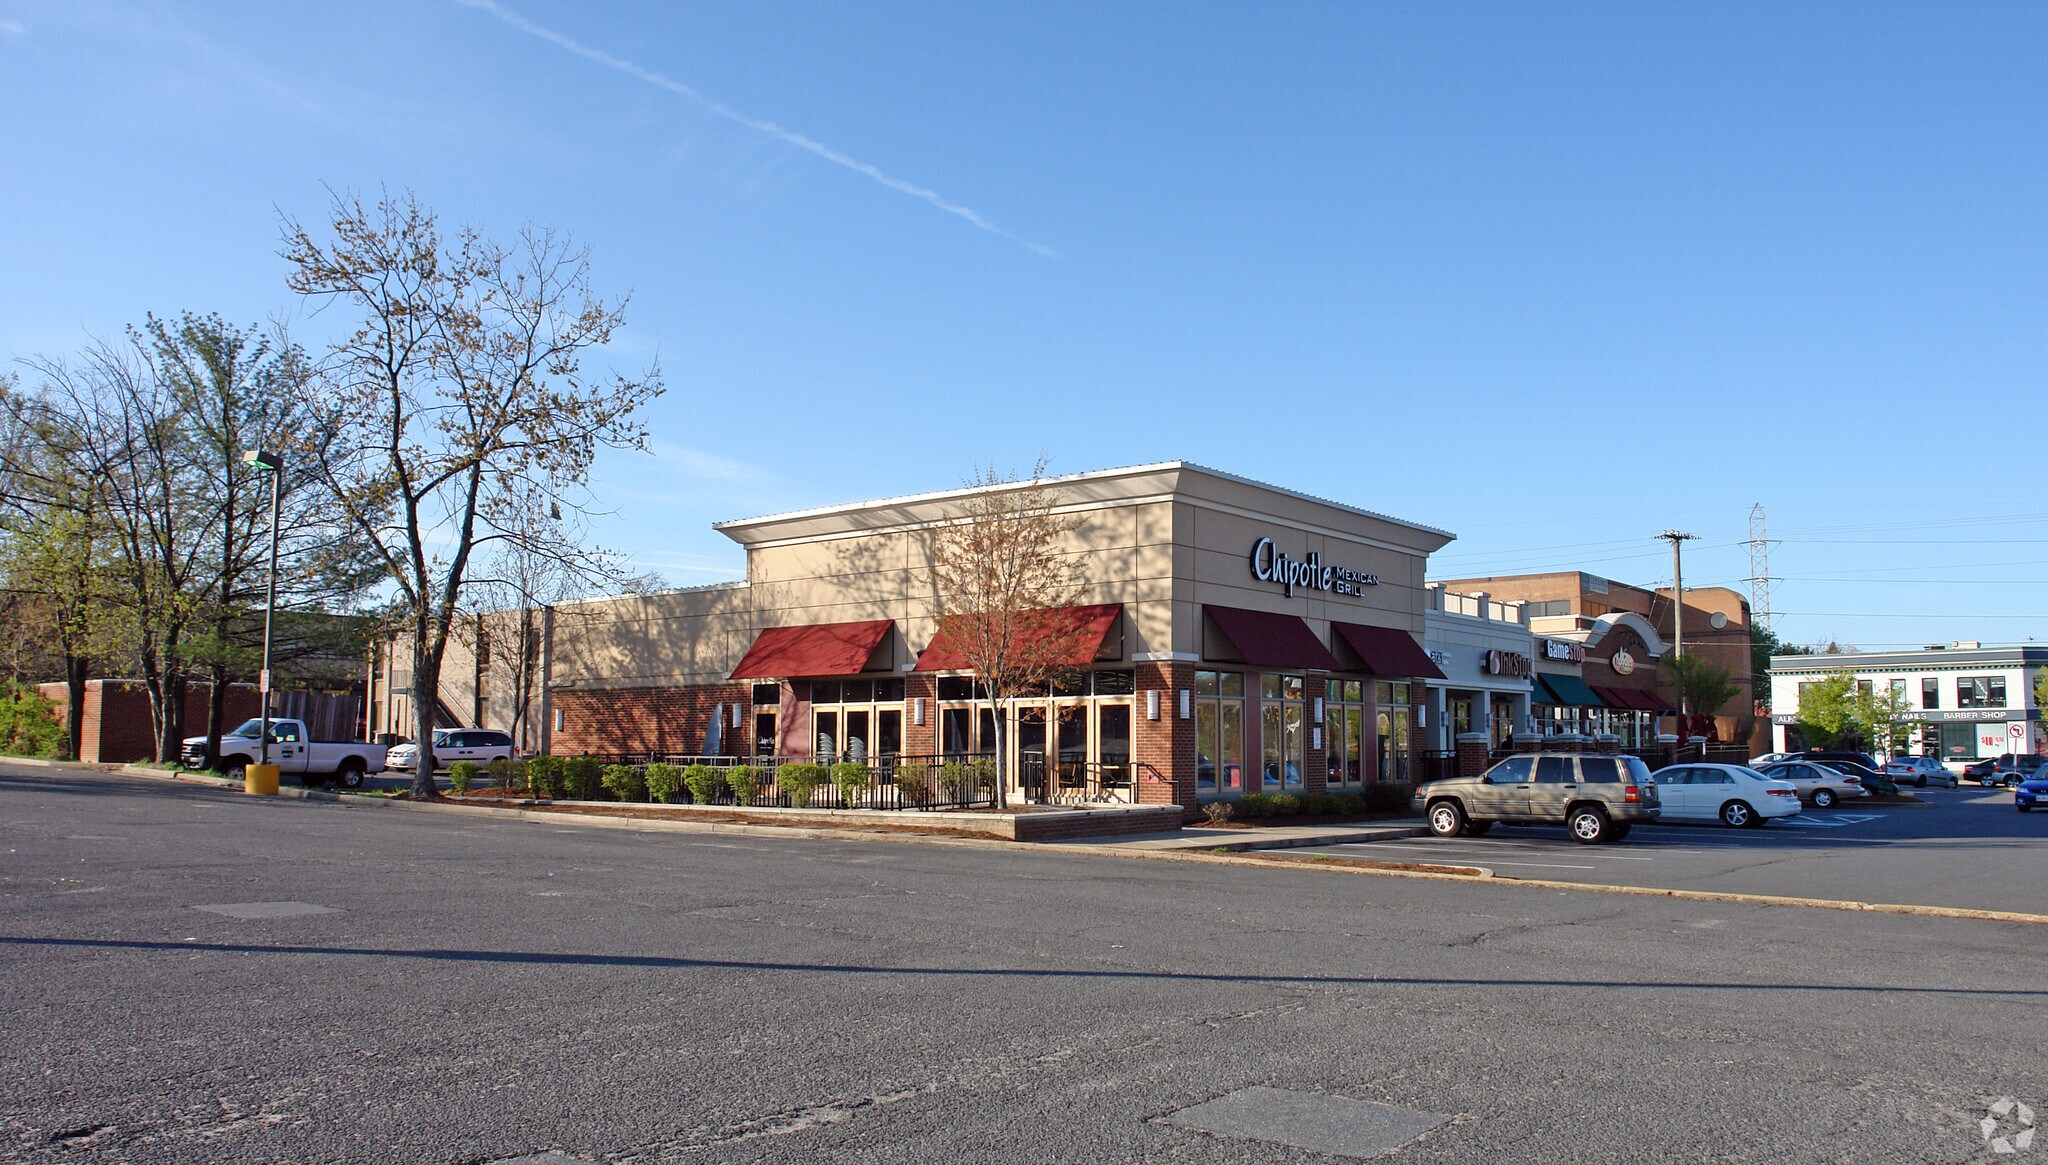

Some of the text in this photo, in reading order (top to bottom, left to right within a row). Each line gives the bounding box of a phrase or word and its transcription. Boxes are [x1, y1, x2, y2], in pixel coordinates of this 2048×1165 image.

[1252, 537, 1332, 598] Chipotle
[1336, 566, 1379, 585] MEXICAN
[1336, 581, 1365, 597] GRILL
[1547, 639, 1585, 663] GameStop
[1500, 650, 1532, 677] InkStop
[1901, 712, 1927, 720] NAILS
[1981, 711, 2007, 719] SHOP
